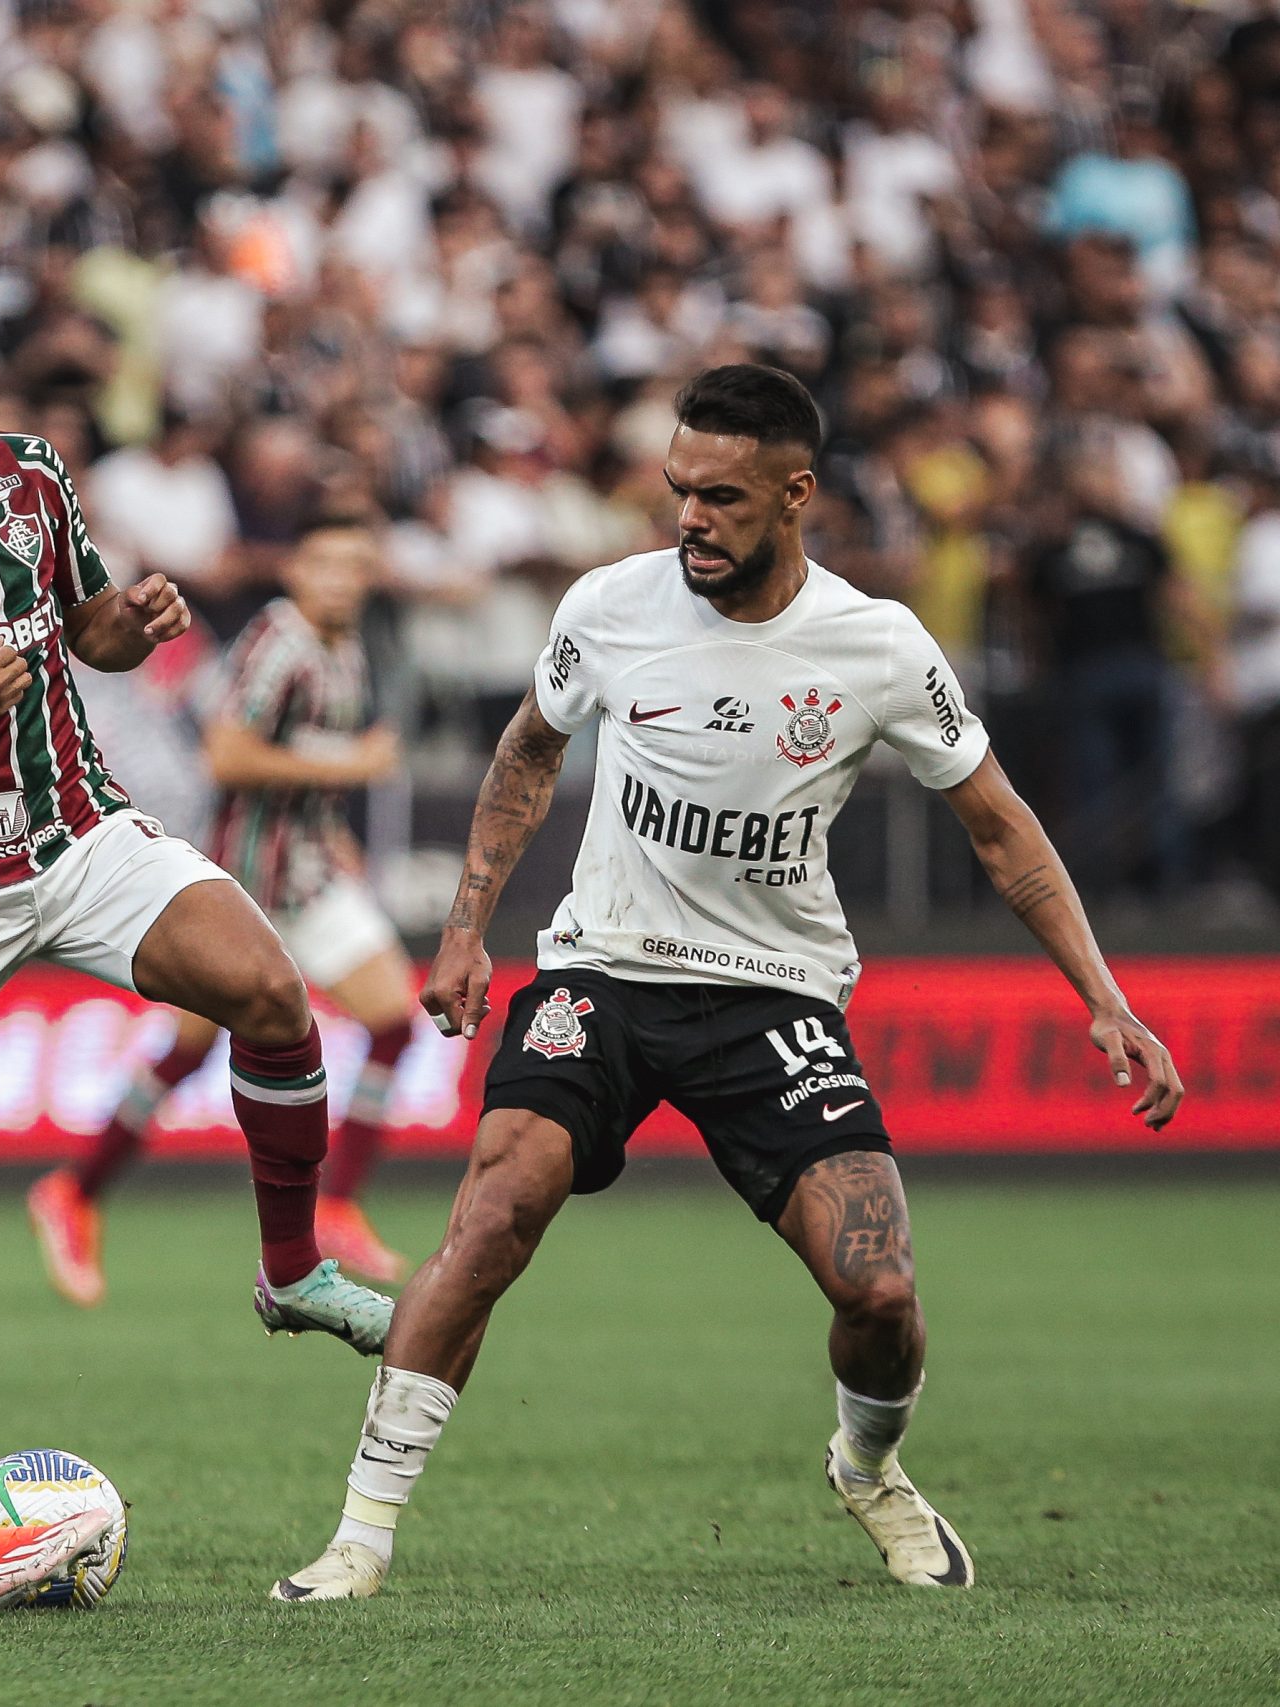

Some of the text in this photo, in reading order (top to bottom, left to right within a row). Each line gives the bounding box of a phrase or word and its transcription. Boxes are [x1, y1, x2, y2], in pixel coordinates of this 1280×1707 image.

[553, 634, 581, 683] bmg
[702, 719, 755, 734] ALE
[930, 682, 962, 748] bmg
[621, 773, 820, 863] VAIDEBET
[734, 863, 808, 887] .COM
[642, 938, 807, 982] GERANDO FALCÕES
[765, 1016, 847, 1076] 14
